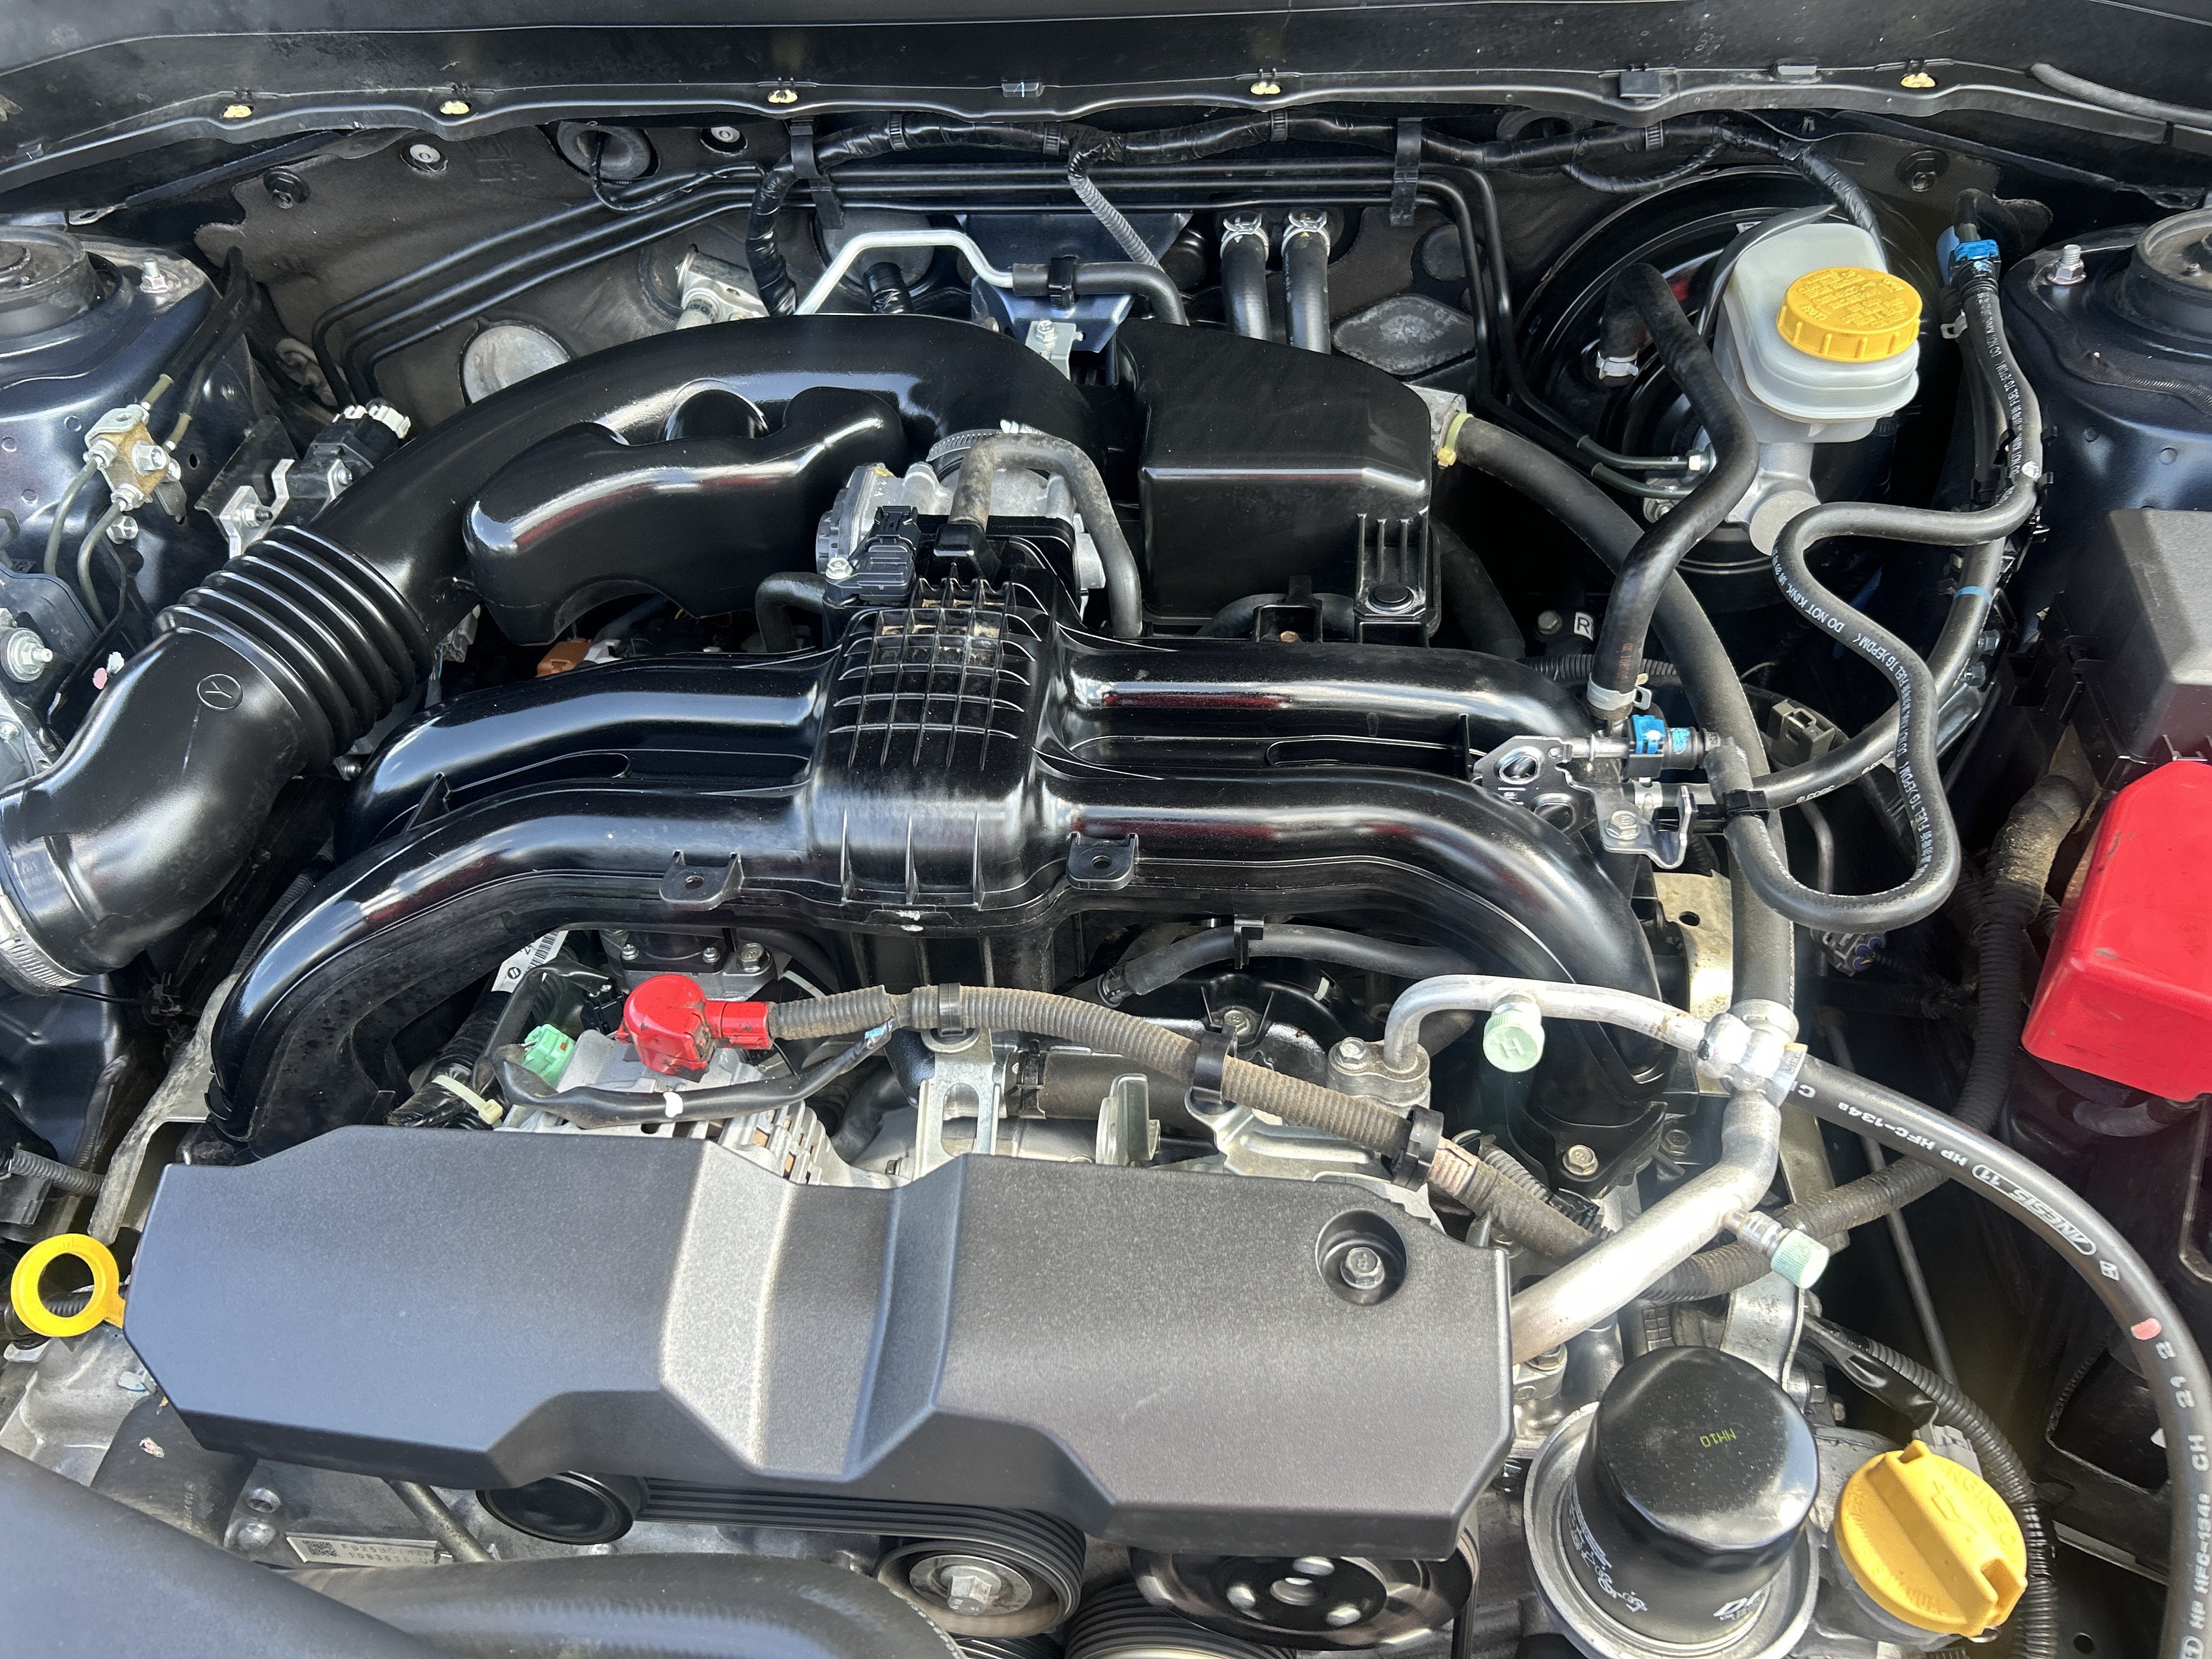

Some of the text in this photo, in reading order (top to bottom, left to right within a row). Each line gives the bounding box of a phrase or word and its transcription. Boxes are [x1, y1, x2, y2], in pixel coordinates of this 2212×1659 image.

[1805, 604, 1829, 623] NOT
[1577, 617, 1590, 634] R
[1827, 618, 1846, 633] DO
[1885, 652, 1899, 672] TG
[1895, 665, 1909, 687] FUEL
[1909, 793, 1922, 810] TG
[1914, 806, 1930, 832] FUEL
[1500, 1037, 1525, 1059] H
[1838, 1102, 1936, 1150] HFC-134a
[1940, 1149, 1968, 1166] HP
[1979, 1169, 2000, 1186] 11
[2155, 1341, 2176, 1359] 2
[2170, 1376, 2194, 1408] 21
[2188, 1434, 2209, 1471] CH
[2194, 1493, 2212, 1594] HFC-134a
[2190, 1600, 2206, 1630] HP
